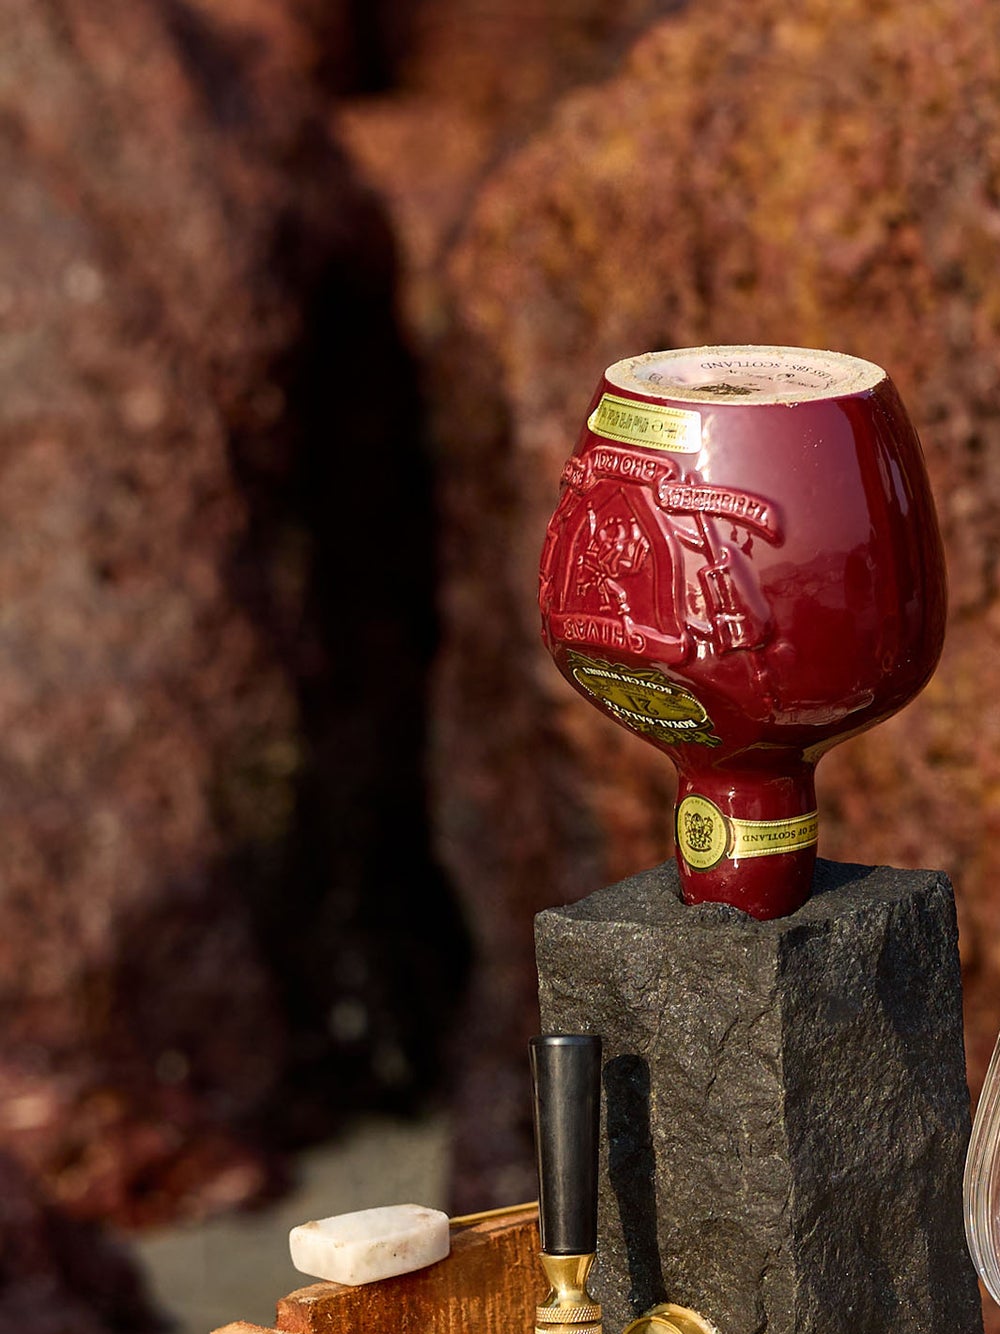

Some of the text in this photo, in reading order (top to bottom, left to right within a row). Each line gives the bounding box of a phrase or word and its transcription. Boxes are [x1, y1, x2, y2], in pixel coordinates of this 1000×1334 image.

[700, 360, 782, 370] SCOTLAND
[563, 618, 646, 655] CHIVAS
[581, 666, 620, 682] WHISKY
[621, 674, 672, 695] SCOTCH
[602, 697, 654, 725] SALUTE
[624, 694, 659, 716] 21
[655, 717, 698, 730] ROYAL
[797, 826, 809, 837] OF
